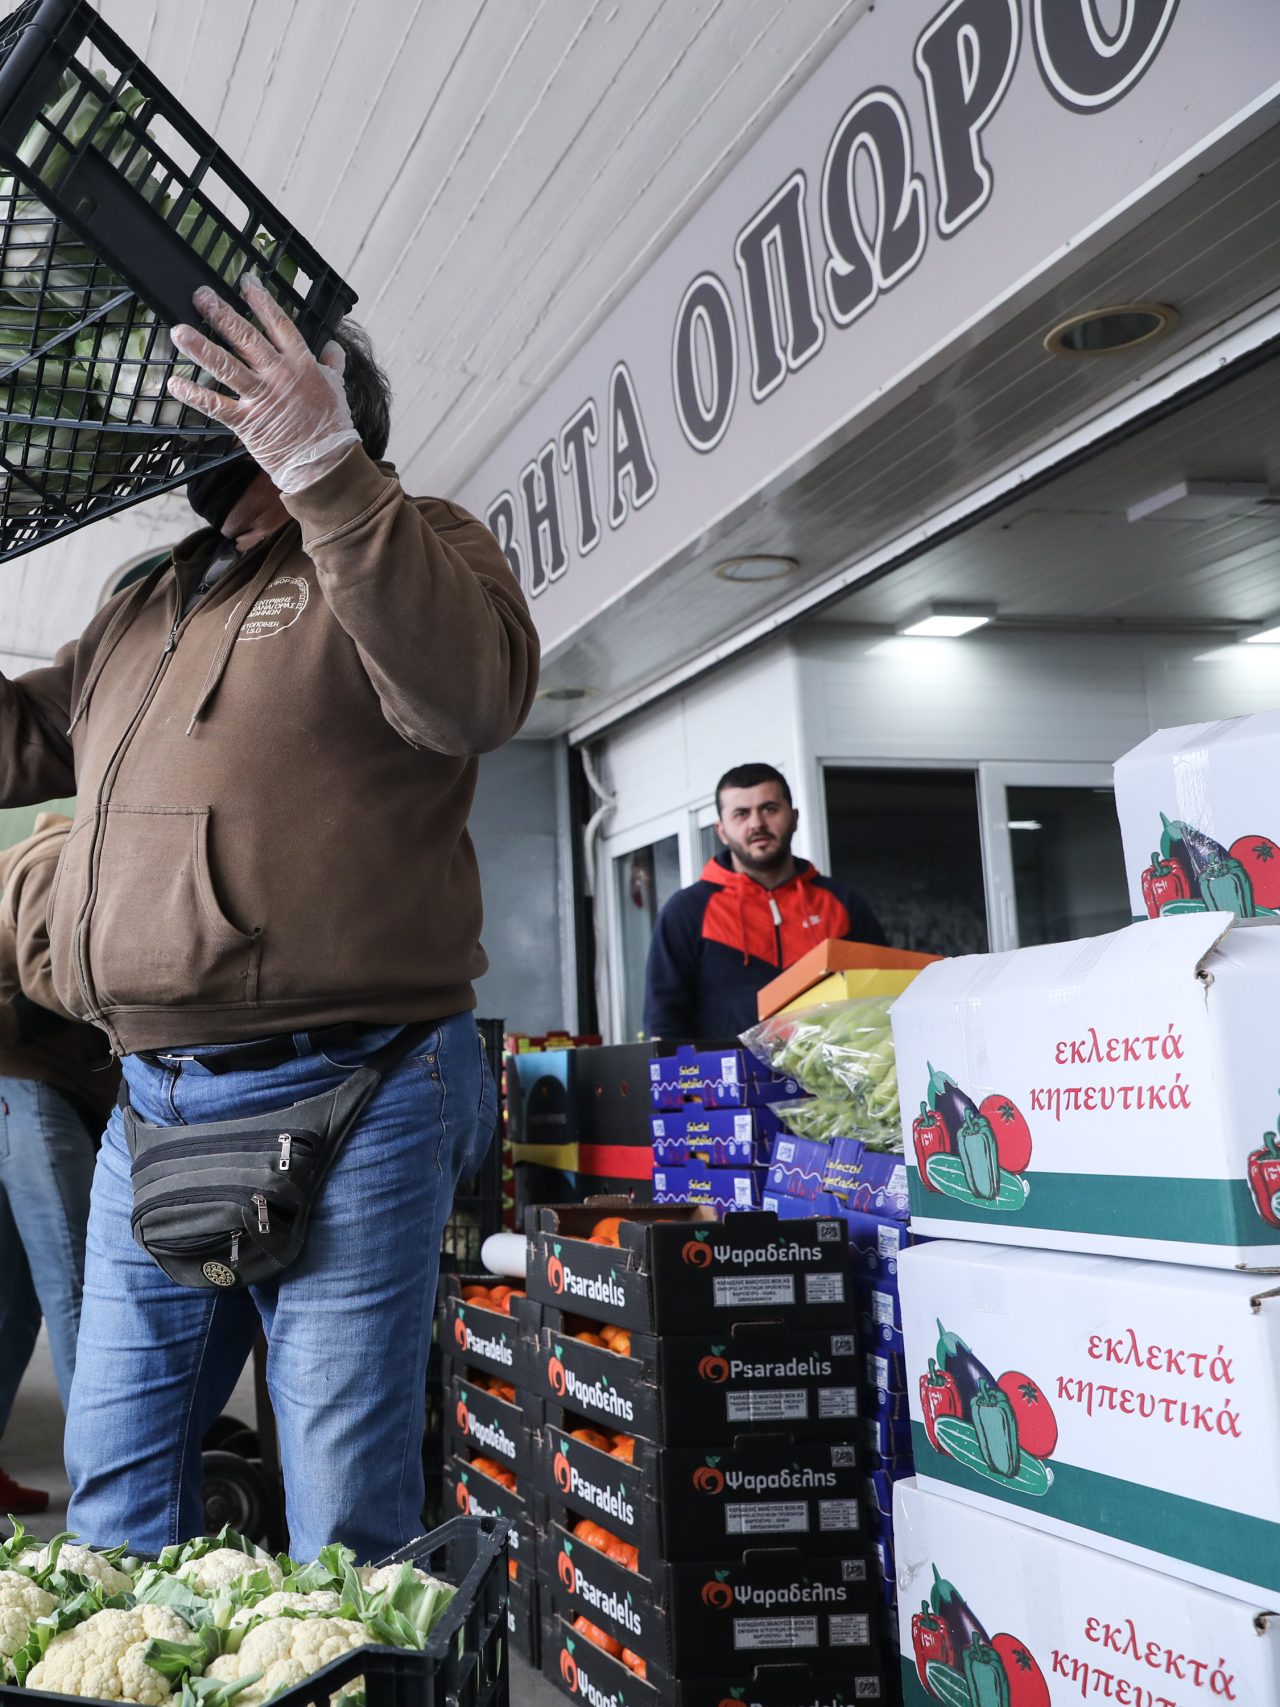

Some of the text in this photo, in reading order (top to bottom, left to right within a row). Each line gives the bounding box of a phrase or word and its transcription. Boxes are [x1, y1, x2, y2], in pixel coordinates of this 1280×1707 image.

[1055, 1023, 1185, 1065] εκλεκτά
[1029, 1072, 1192, 1122] κηπευτικά
[563, 1266, 625, 1308] Psaradelis
[730, 1352, 832, 1379] Psaradelis
[1087, 1328, 1236, 1385] εκλεκτά
[1056, 1375, 1242, 1438] κηπευτικά
[570, 1466, 634, 1526] Psaradelis
[574, 1567, 642, 1635] Psaradelis
[1051, 1649, 1183, 1707] κηπευ
[1084, 1616, 1236, 1701] εκλεκτά
